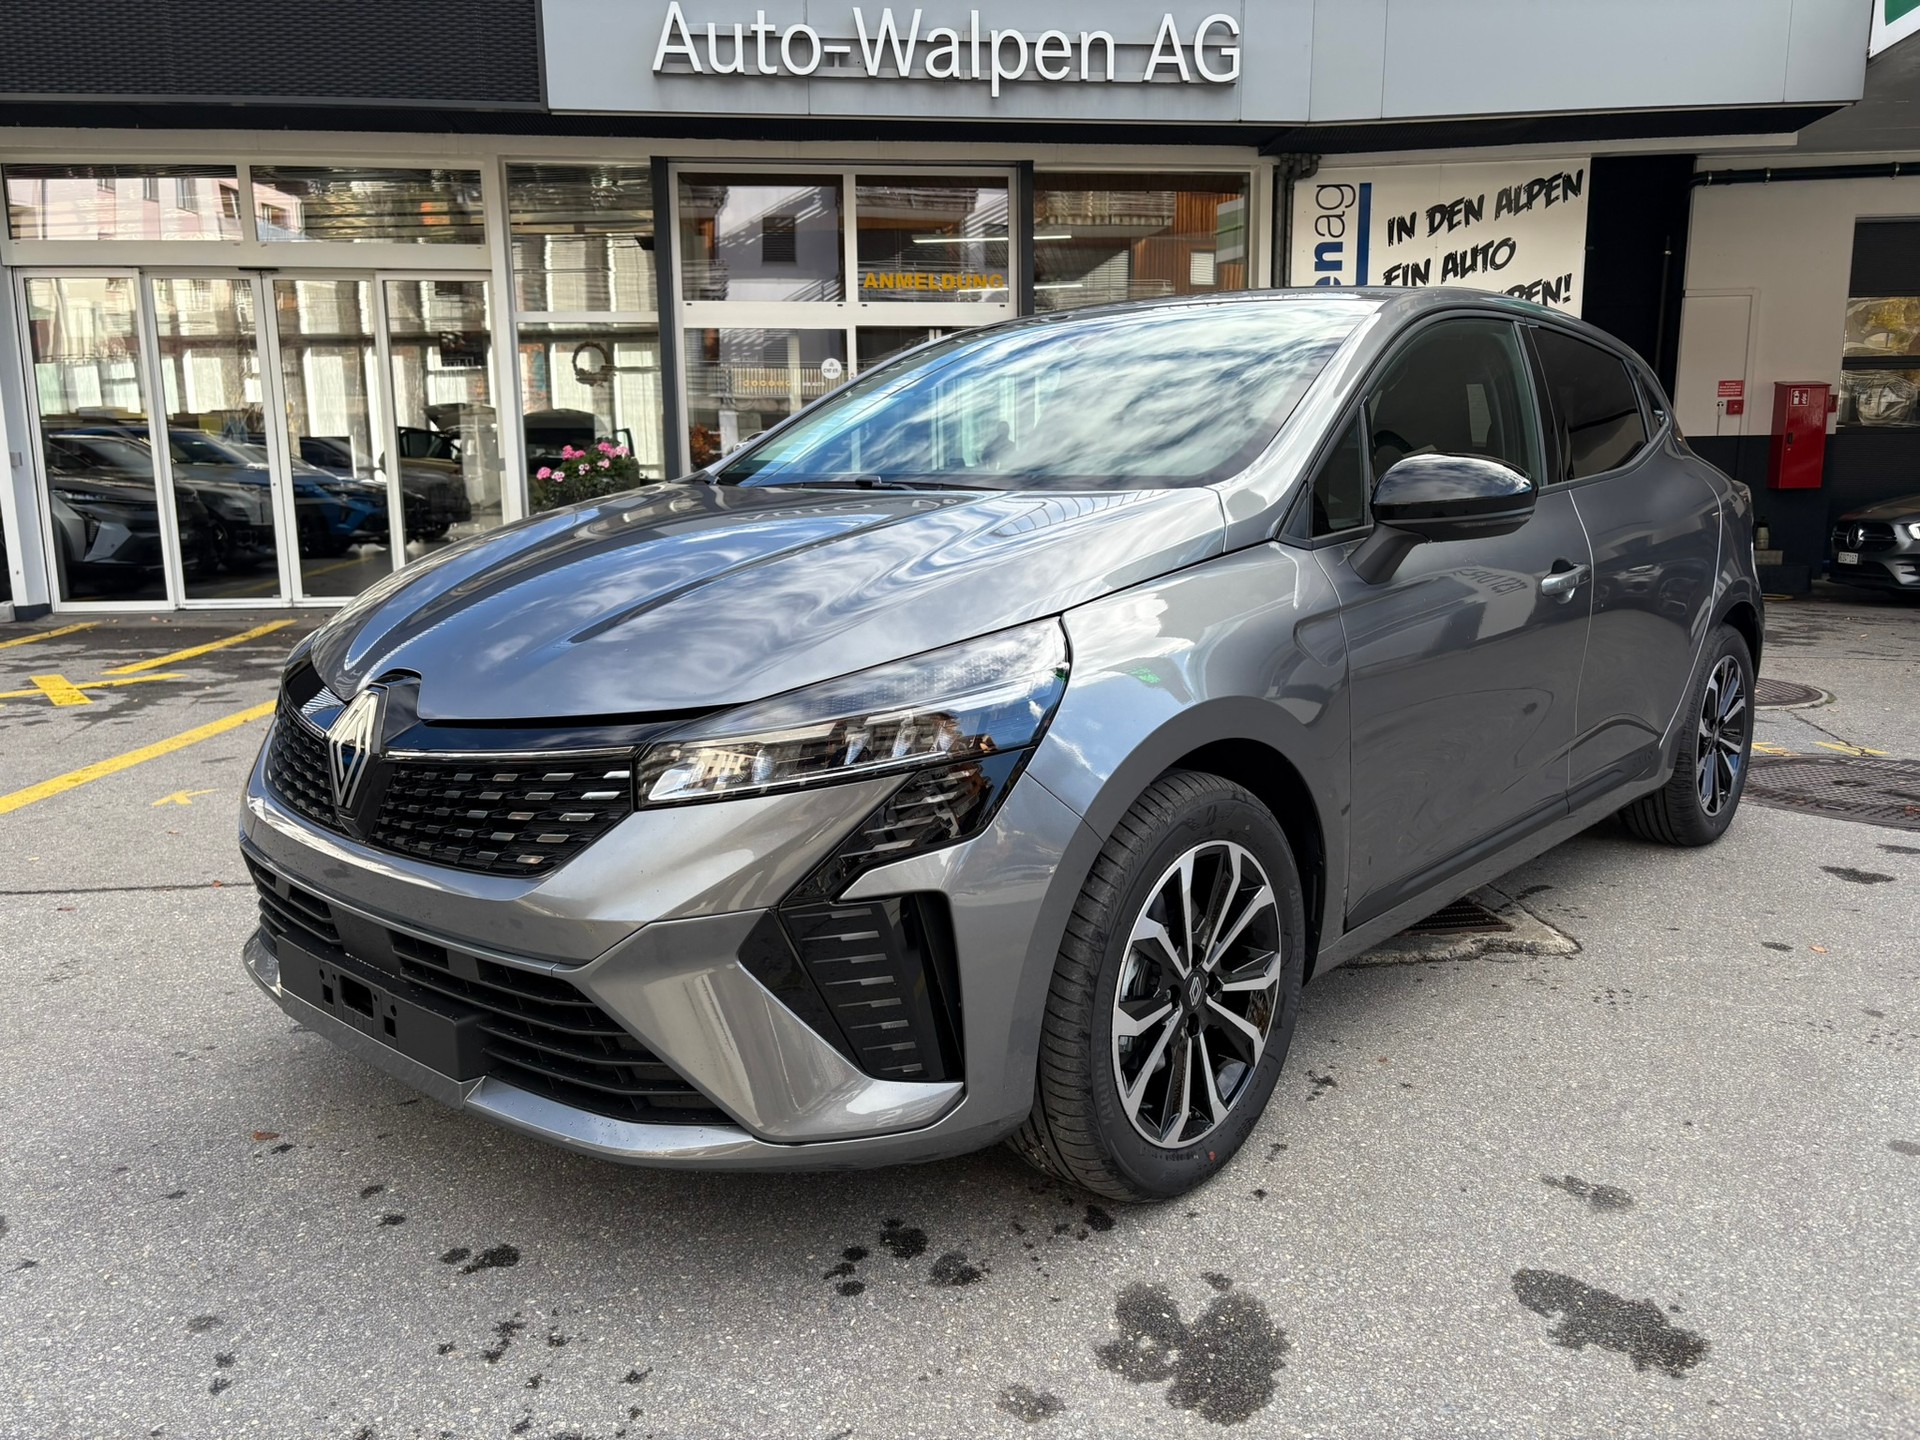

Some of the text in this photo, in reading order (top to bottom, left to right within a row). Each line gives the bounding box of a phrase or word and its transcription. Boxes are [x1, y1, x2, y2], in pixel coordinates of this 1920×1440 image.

[652, 1, 1240, 98] Auto-Walpen AG
[1387, 168, 1584, 247] IN DEN ALPEN
[863, 271, 1005, 291] ANMELDUNG
[1440, 237, 1517, 285] AUTO
